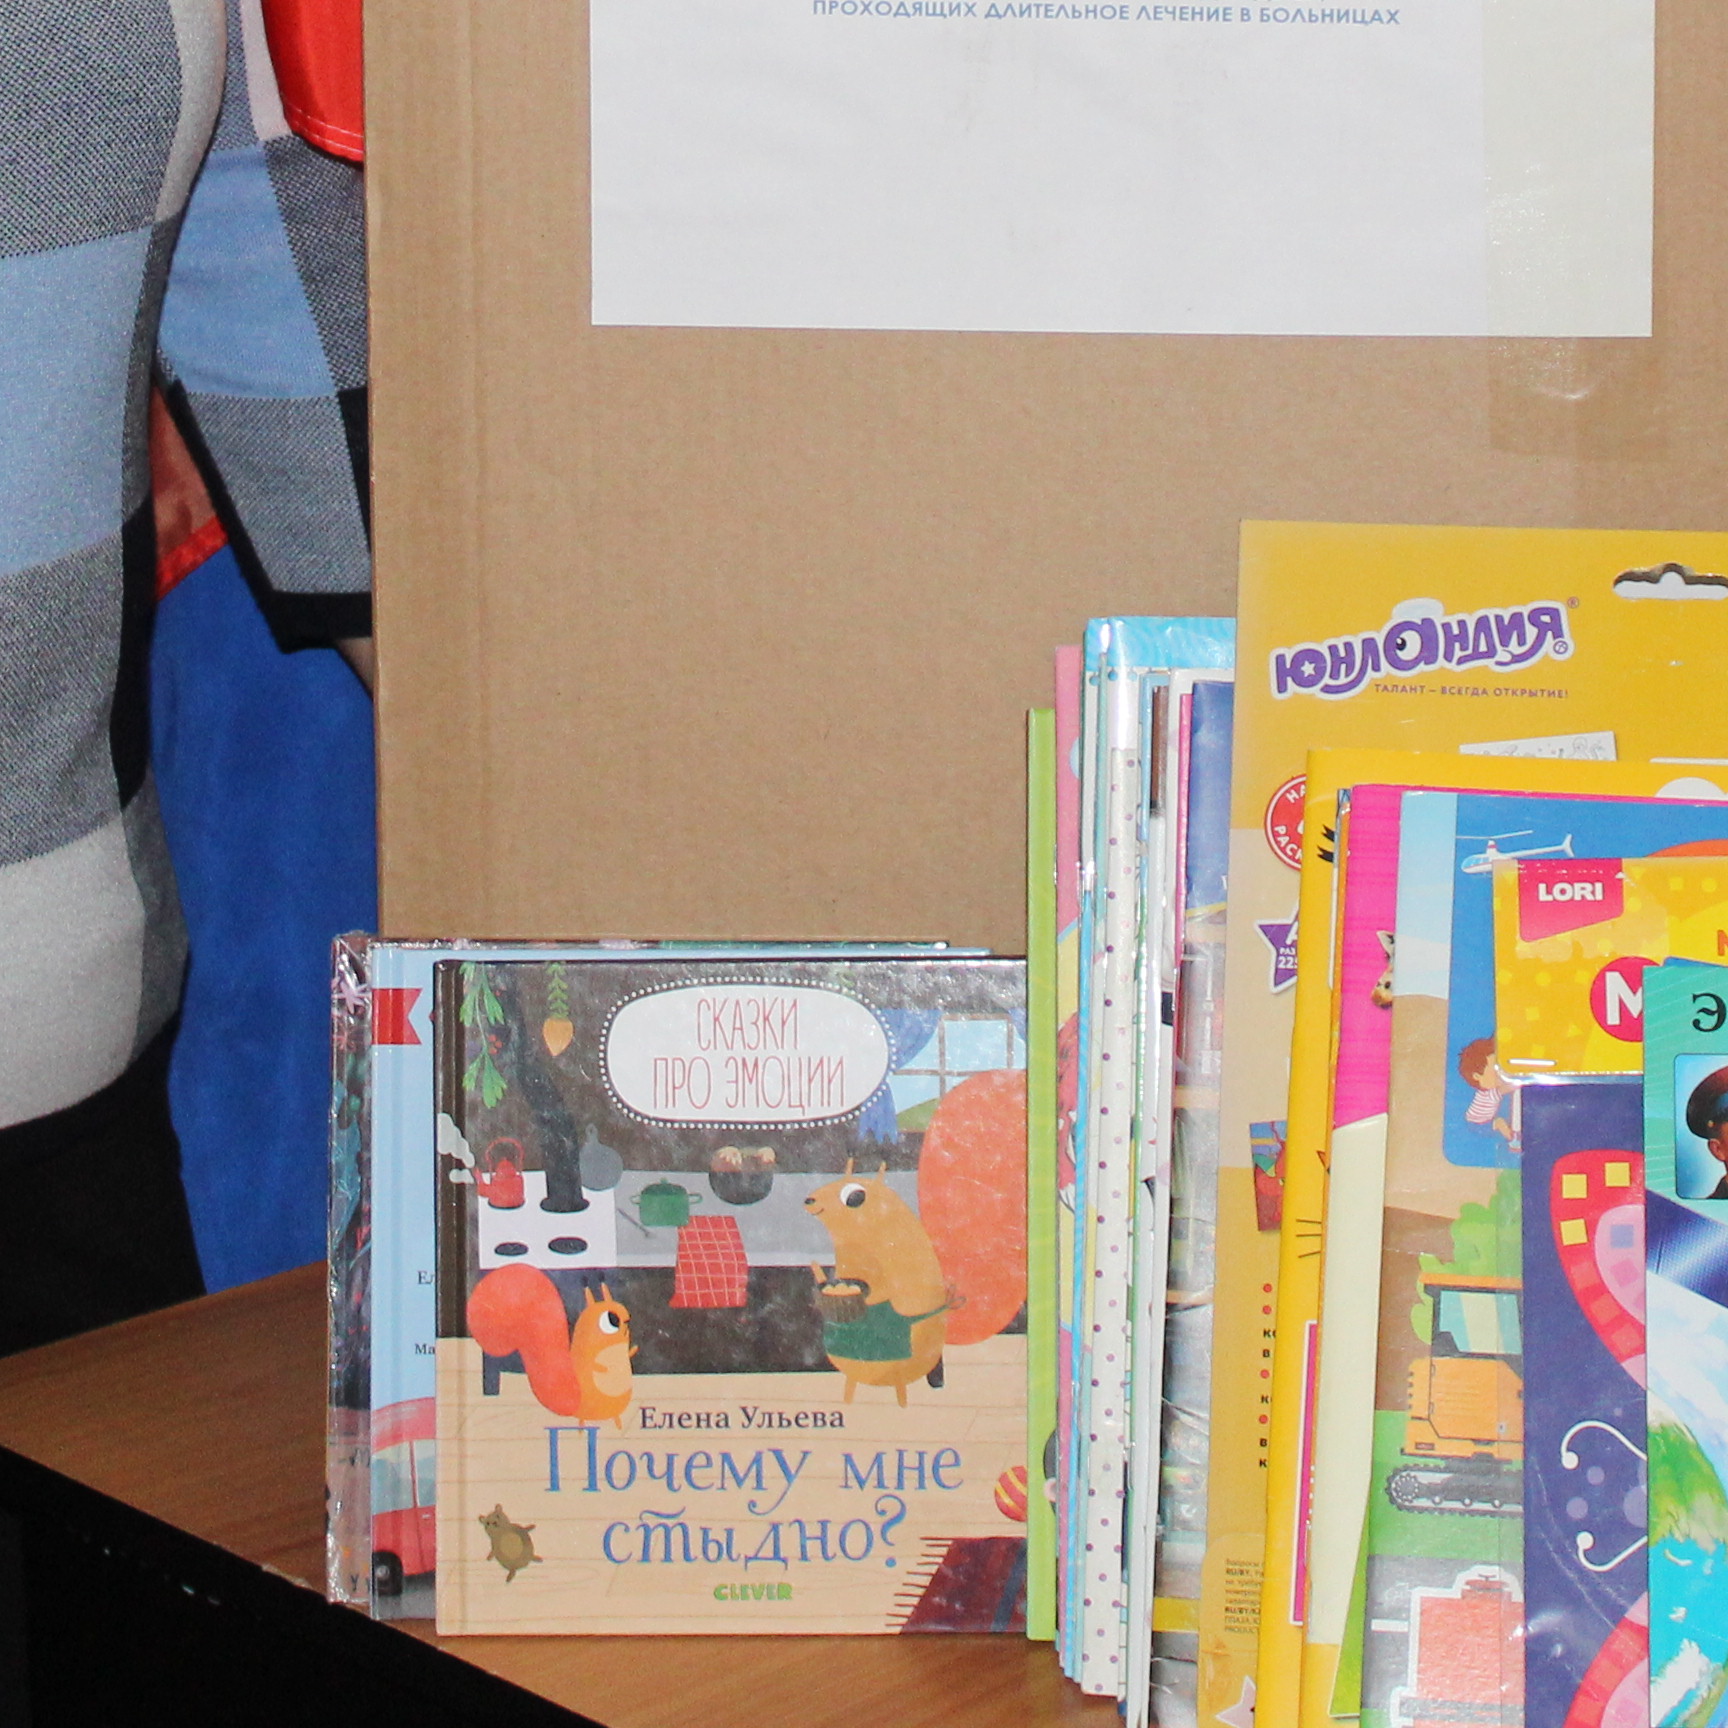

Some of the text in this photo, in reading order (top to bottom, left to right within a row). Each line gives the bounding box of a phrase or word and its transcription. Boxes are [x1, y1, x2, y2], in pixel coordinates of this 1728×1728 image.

[813, 0, 1401, 27] ПРОХОДЯЩИХ ДЛИТЕЛЬНОЕ ЛЕЧЕНИЕ В БОЛЬНИЦАХ
[1374, 683, 1425, 694] ТАЛАНТ
[1440, 685, 1489, 697] ВСЕГДА
[1493, 687, 1569, 698] ОТКРЫТИЕ!
[1538, 882, 1604, 901] LORI
[697, 996, 799, 1052] СКАЗКИ
[652, 1055, 845, 1116] ПРО ЭМОЦИИ
[639, 1405, 845, 1432] Елена Ульева
[543, 1425, 965, 1515] Почему мне
[602, 1494, 908, 1571] стыдно?
[713, 1582, 793, 1602] CLEVER
